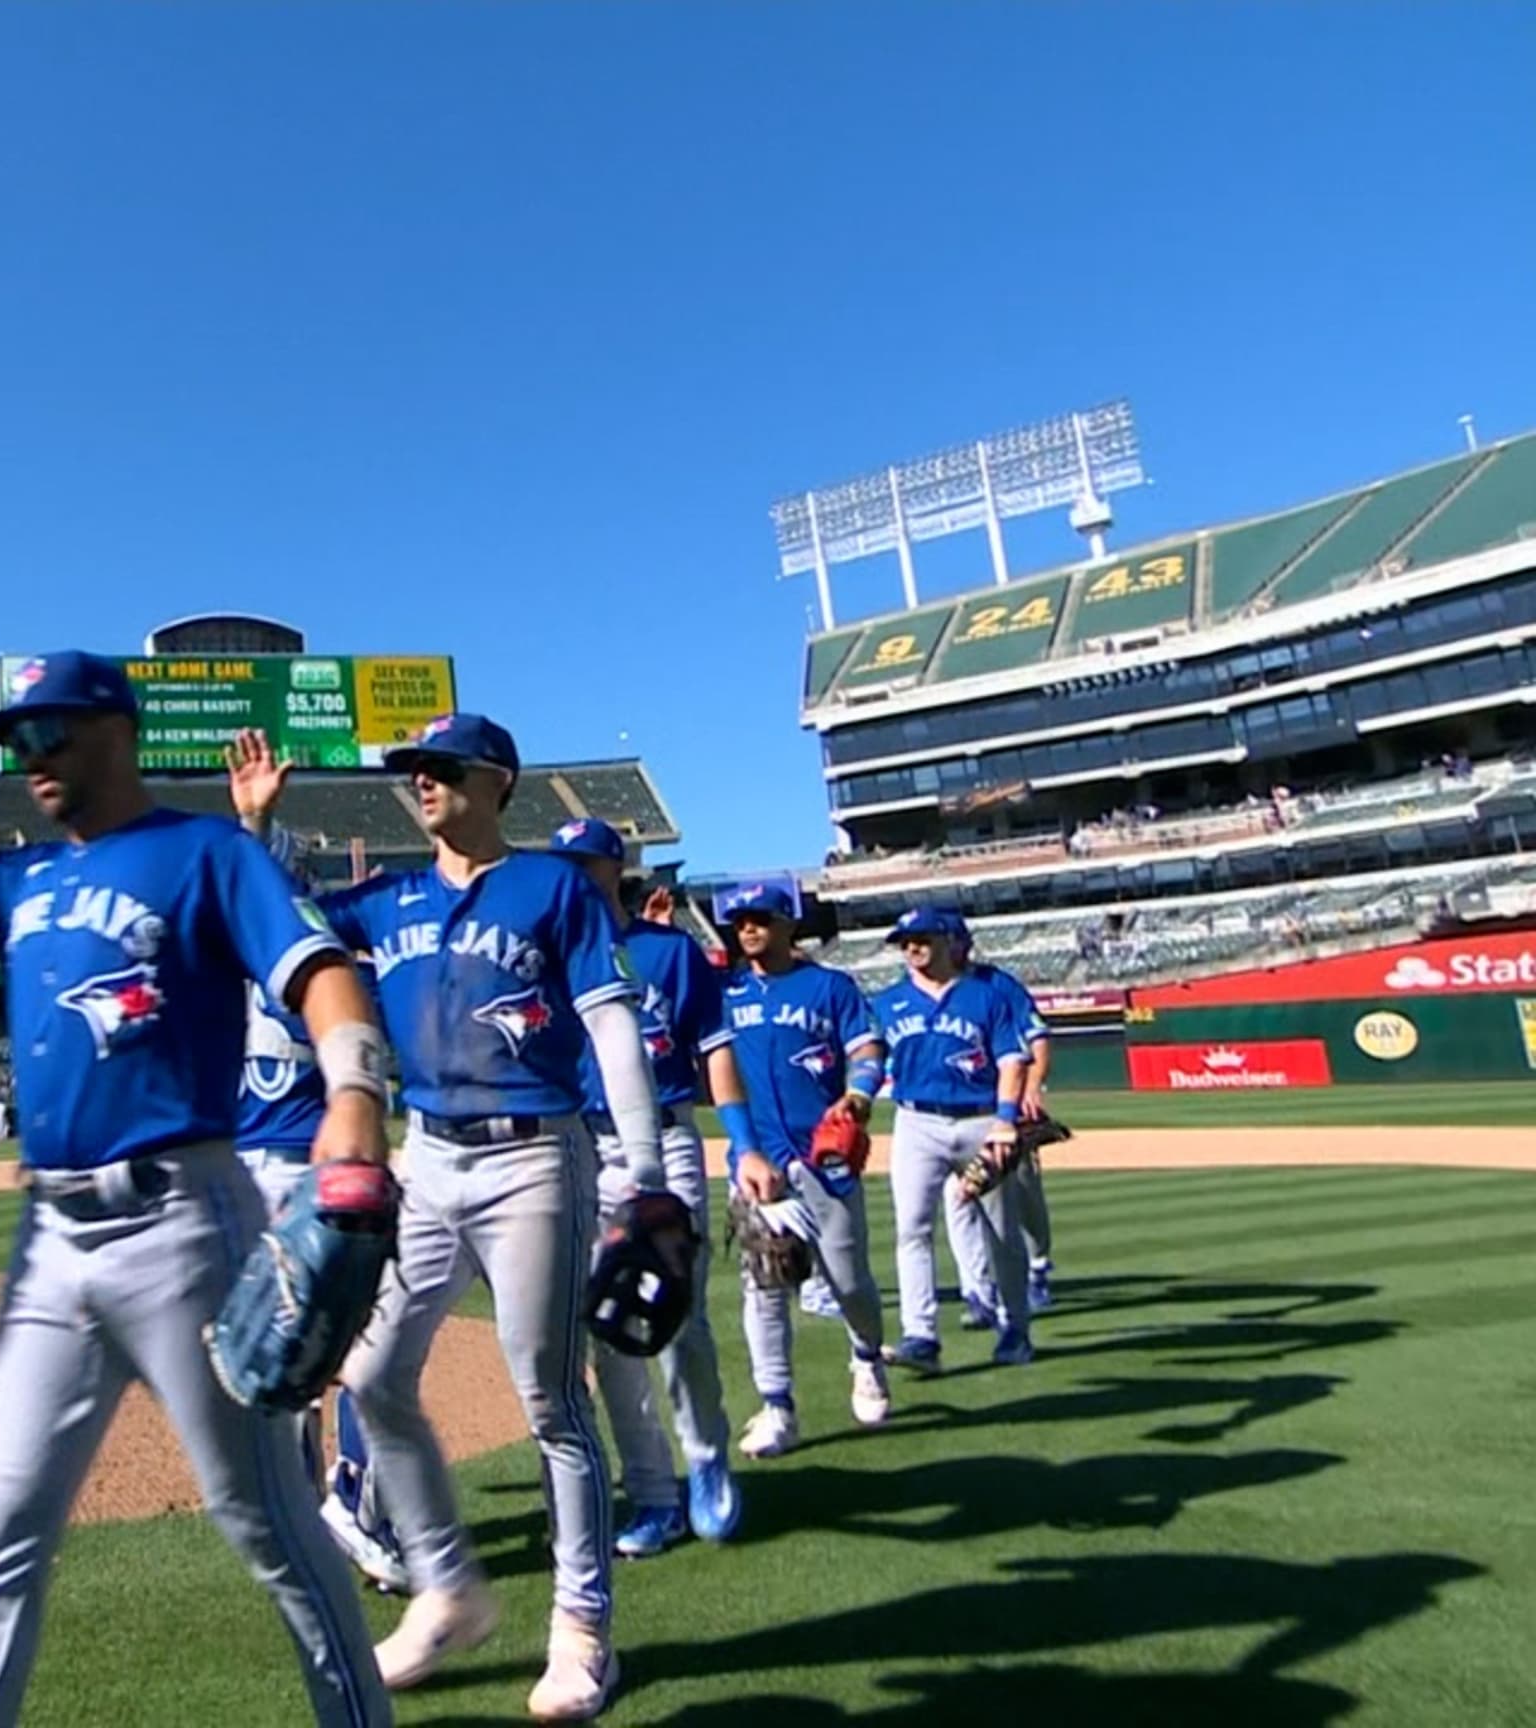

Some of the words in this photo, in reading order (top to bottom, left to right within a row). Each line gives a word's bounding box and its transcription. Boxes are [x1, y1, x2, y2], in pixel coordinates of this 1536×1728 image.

[1088, 556, 1183, 592] 43
[968, 597, 1051, 636] 24
[875, 634, 916, 662] 9
[168, 661, 208, 678] HOME
[214, 661, 254, 678] GAME
[163, 700, 200, 714] CHRIS
[285, 692, 346, 713] $5,700
[165, 729, 189, 742] KEN
[56, 886, 164, 957] JAYS
[449, 921, 545, 982] JAYS
[1449, 950, 1536, 985] Stat
[732, 1004, 764, 1028] UE
[1363, 1021, 1402, 1038] RAY
[1168, 1068, 1289, 1088] Budweiser
